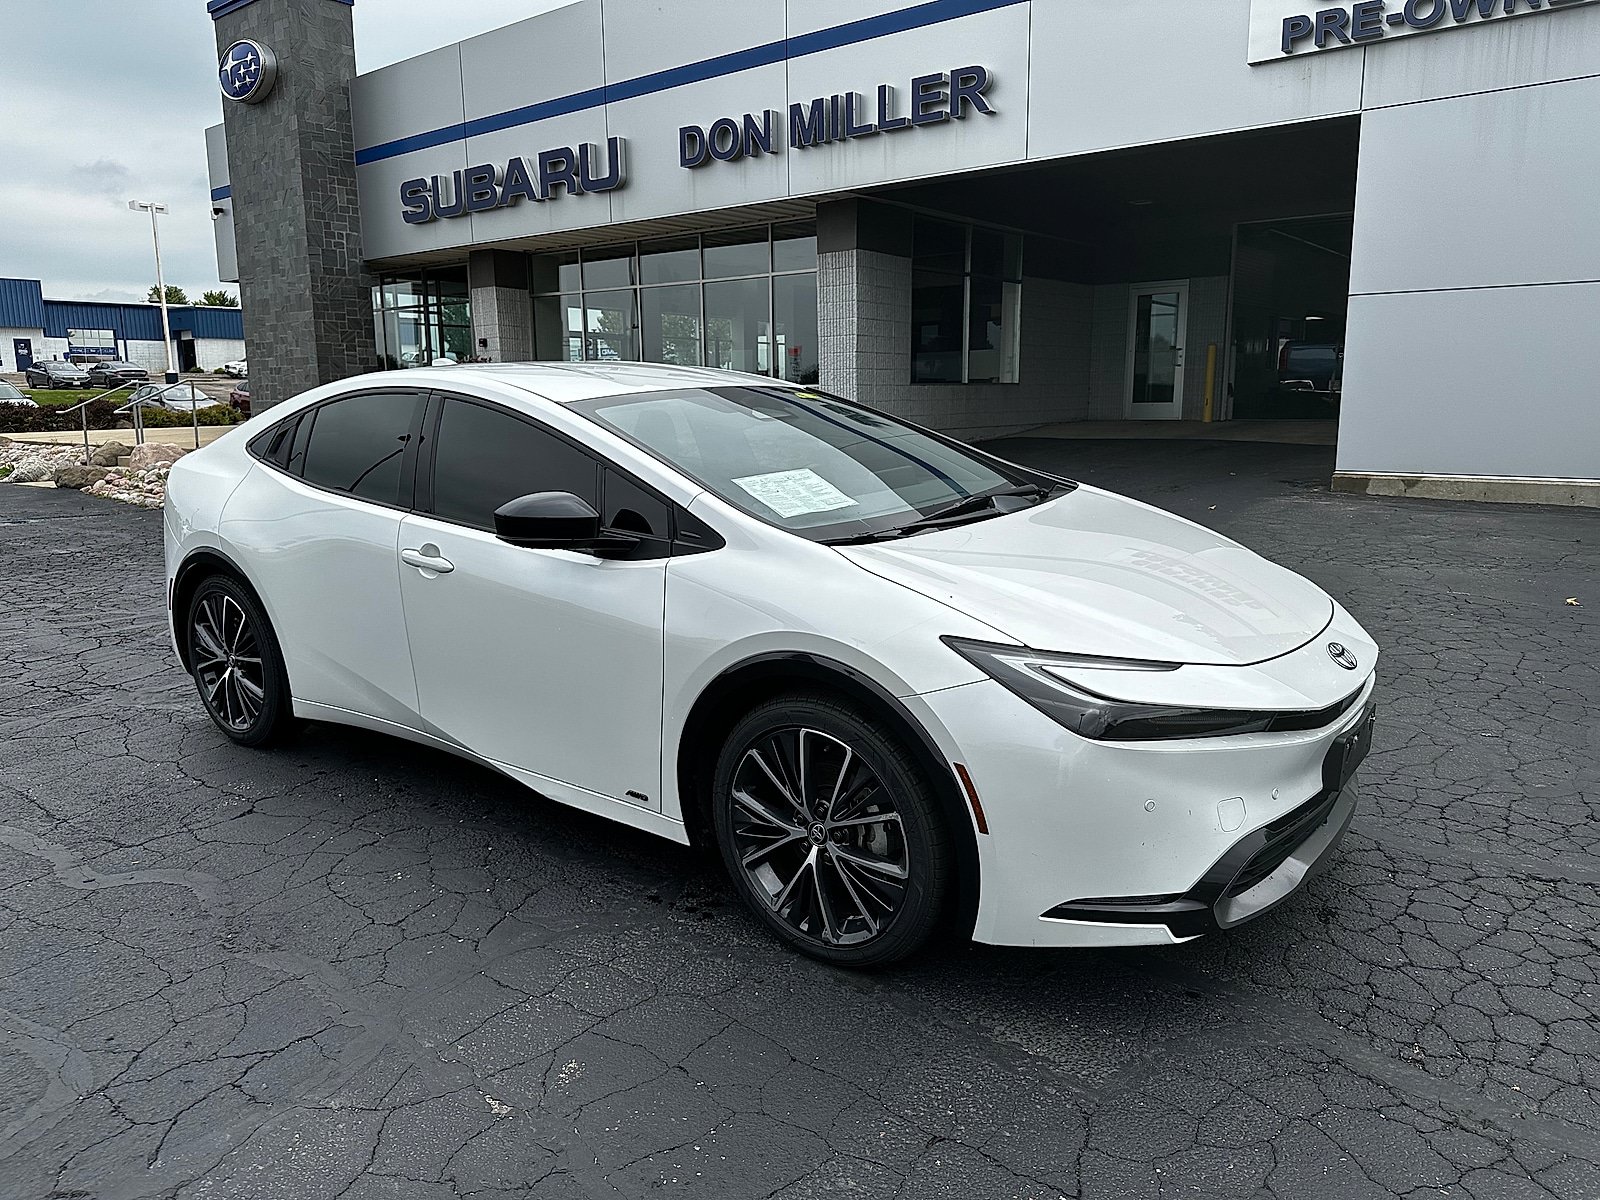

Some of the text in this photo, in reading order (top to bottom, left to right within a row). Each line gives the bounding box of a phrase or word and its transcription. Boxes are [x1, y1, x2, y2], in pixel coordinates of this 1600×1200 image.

[679, 65, 996, 170] DON MILLER
[400, 136, 626, 224] SUBARU
